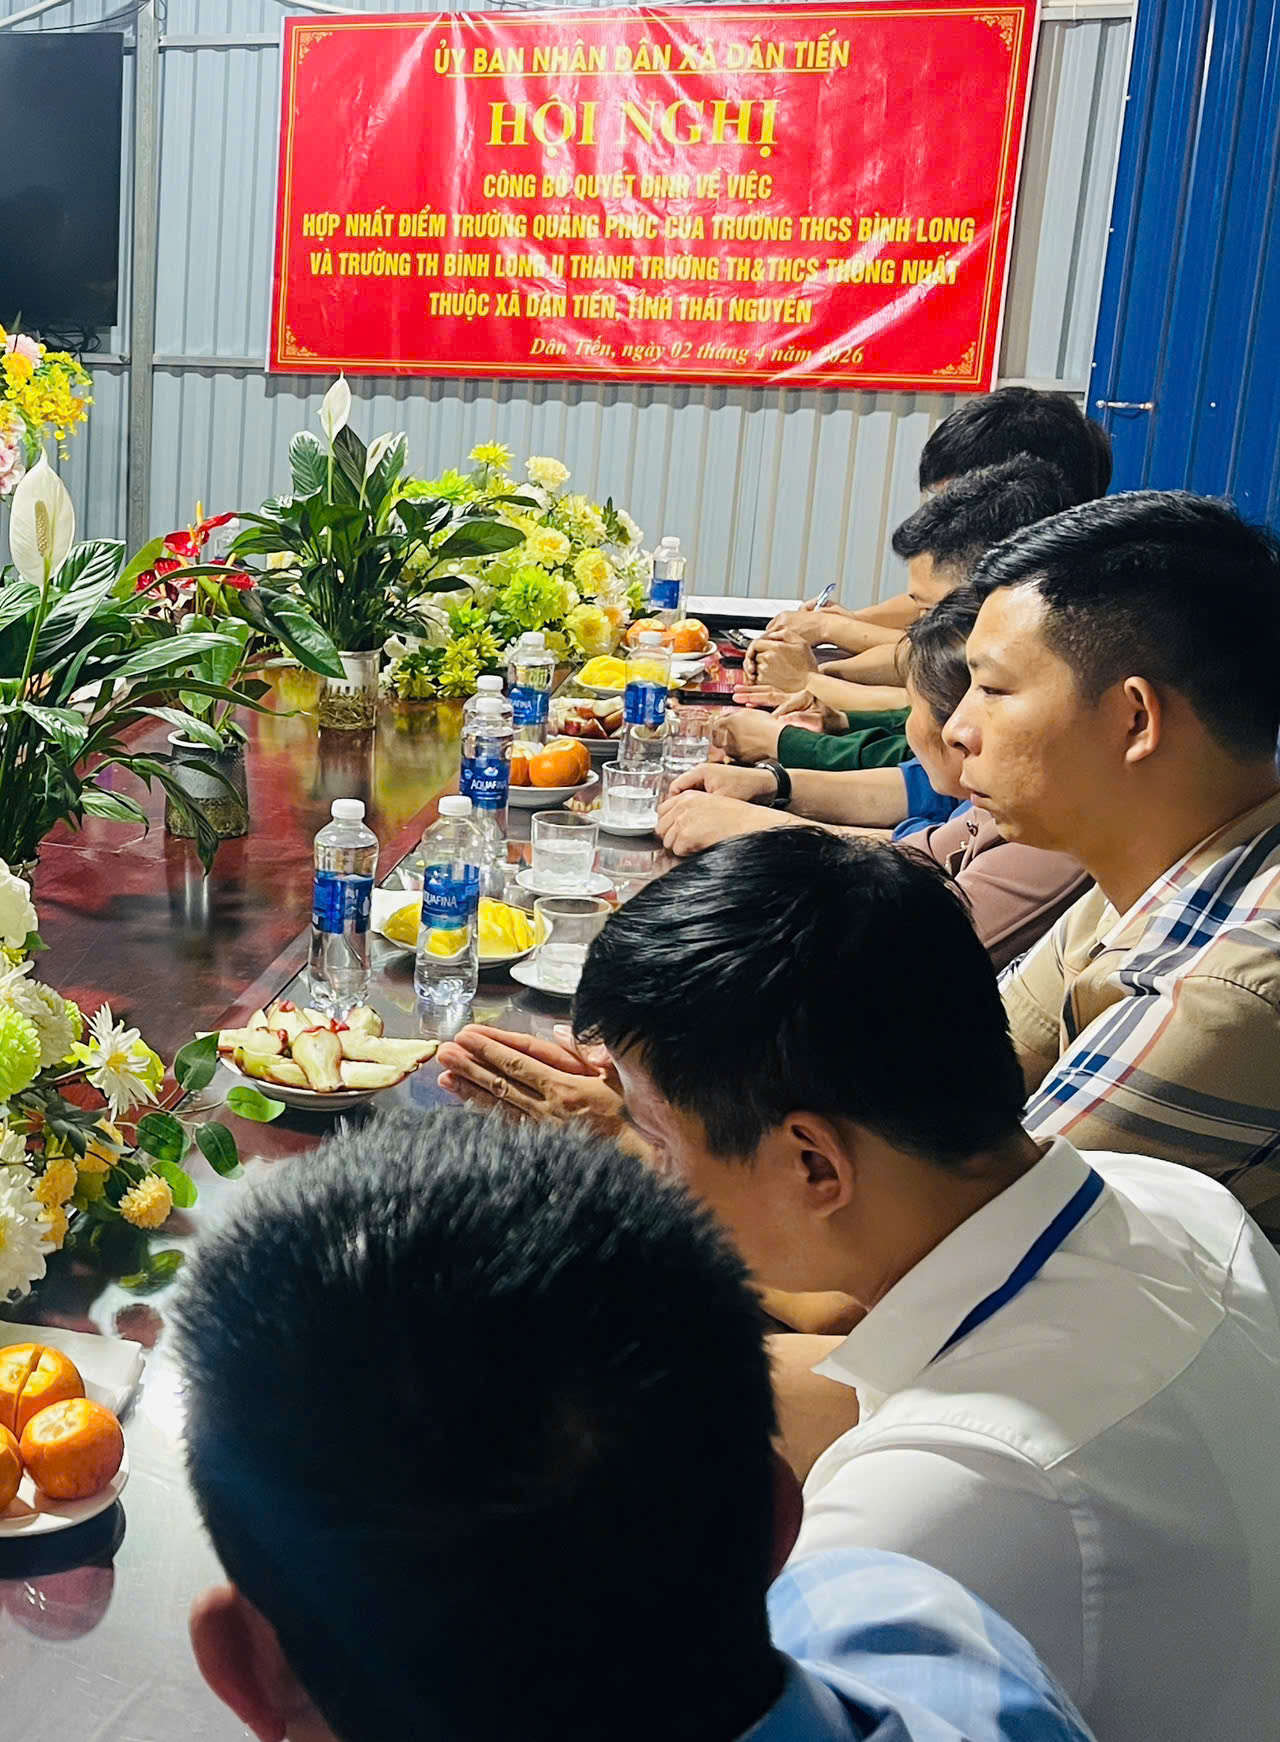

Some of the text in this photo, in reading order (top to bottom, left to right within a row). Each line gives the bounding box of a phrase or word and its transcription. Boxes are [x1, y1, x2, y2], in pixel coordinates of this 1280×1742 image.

[434, 28, 850, 74] ỦY BAN NHÂN DÂN XÃ DÂN TIẾN
[486, 94, 781, 158] HỘI NGHỊ
[483, 170, 536, 198] CÔNG
[574, 166, 636, 201] QUYẾT
[640, 174, 690, 204] ĐỊNH
[695, 168, 721, 199] VỀ
[727, 169, 773, 204] VIỆC
[303, 213, 340, 241] HỢP
[345, 204, 395, 237] NHẤT
[398, 203, 446, 238] ĐIỂM
[452, 210, 527, 239] TRƯỜNG
[532, 206, 599, 240] QUẢNG
[605, 211, 658, 240] PHÚC
[711, 209, 793, 241] TRƯỜNG
[799, 216, 852, 242] THCS
[857, 211, 912, 243] BÌNH
[916, 217, 976, 244] LONG
[310, 248, 333, 275] VÀ
[338, 247, 411, 277] TRƯỜNG
[416, 253, 439, 277] TH
[444, 249, 490, 277] BÌNH
[494, 254, 546, 278] LONG
[551, 254, 564, 279] II
[570, 251, 634, 279] THÀNH
[640, 250, 719, 281] TRƯỜNG
[725, 256, 820, 284] TH&THCS
[901, 251, 961, 286] NHẤT
[429, 288, 813, 325] THUỘC XÃ DÂN TIẾN, TỈNH THÁI NGUYÊN
[530, 337, 567, 356] Dân
[576, 335, 617, 359] Tiến,
[622, 341, 667, 362] ngày
[670, 341, 691, 360] 02
[696, 341, 750, 365] tháng
[754, 343, 768, 361] 4
[771, 343, 813, 363] năm
[423, 890, 458, 909] QUAFINA
